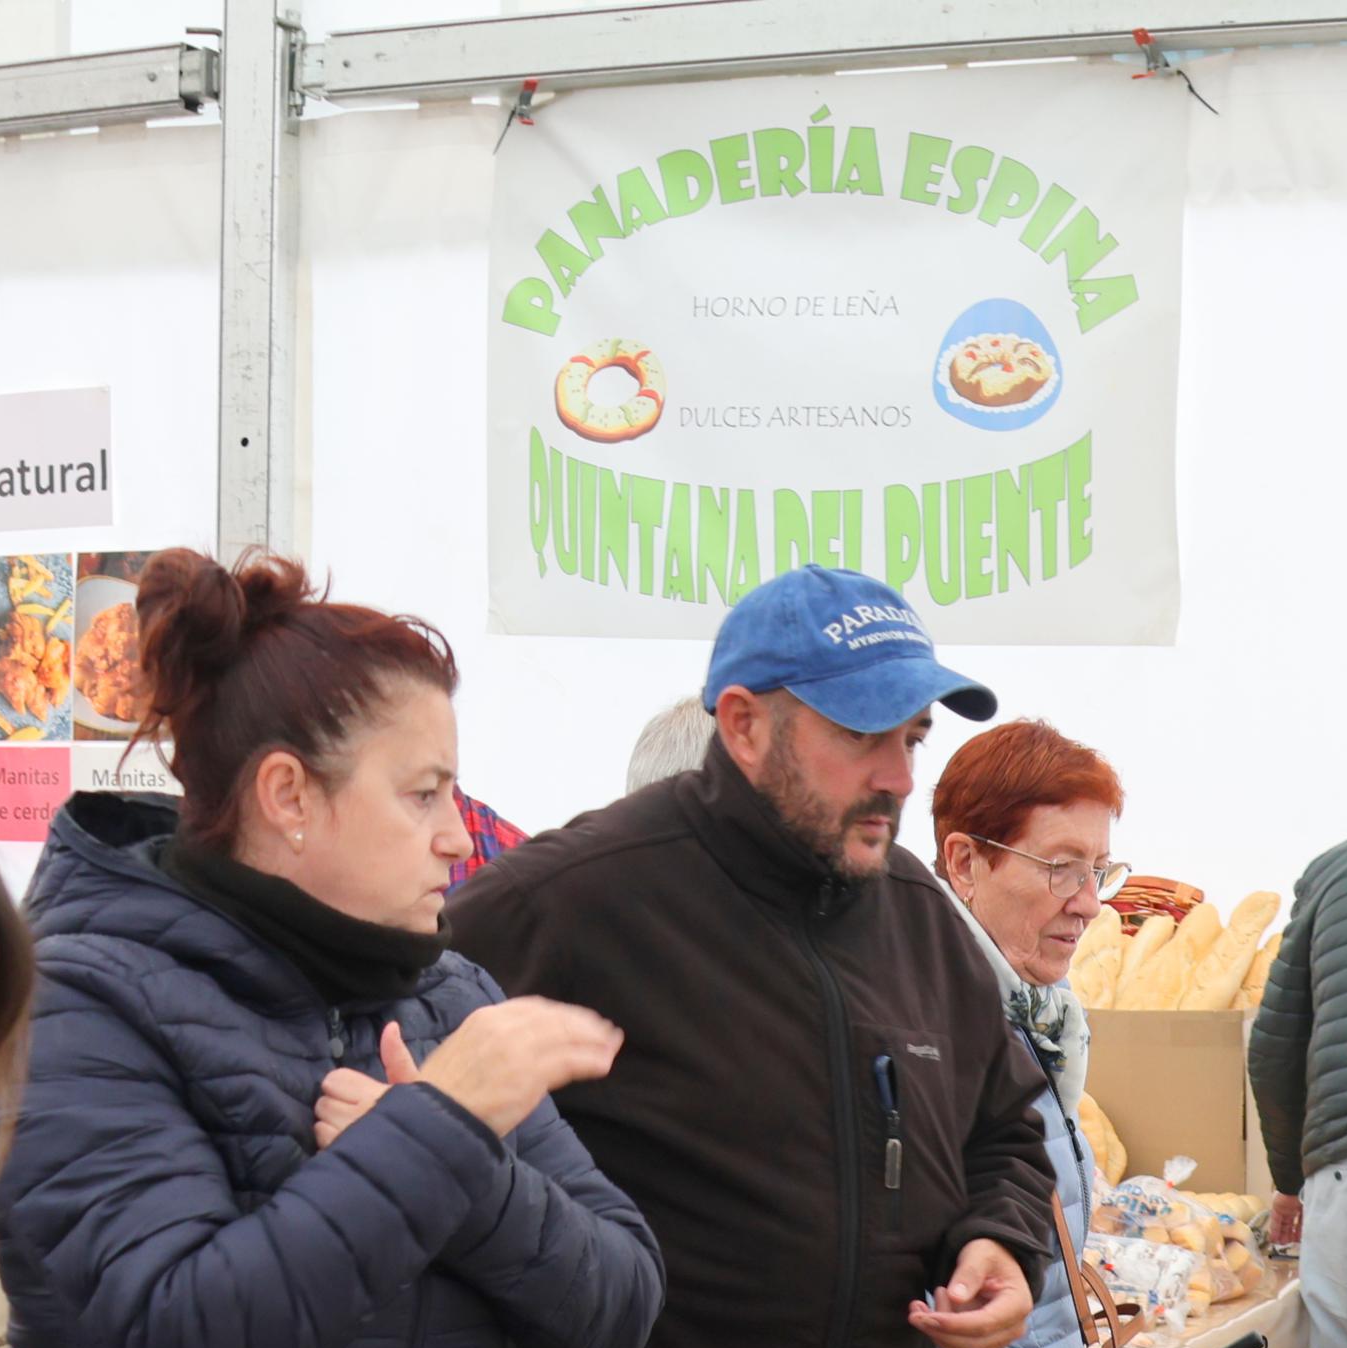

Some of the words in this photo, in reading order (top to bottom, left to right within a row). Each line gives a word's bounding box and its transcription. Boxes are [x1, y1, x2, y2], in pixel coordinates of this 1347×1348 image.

[502, 104, 883, 338] PANADERÍA
[900, 130, 1139, 335] ESPINA
[692, 295, 787, 319] HORNO
[793, 295, 827, 318] DE
[833, 289, 900, 318] LEÑA
[679, 404, 761, 430] DULCES
[766, 403, 912, 430] ARTESANOS
[528, 425, 760, 608] QUINTANA
[884, 430, 1094, 607] PUENTE
[92, 768, 167, 788] Manitas
